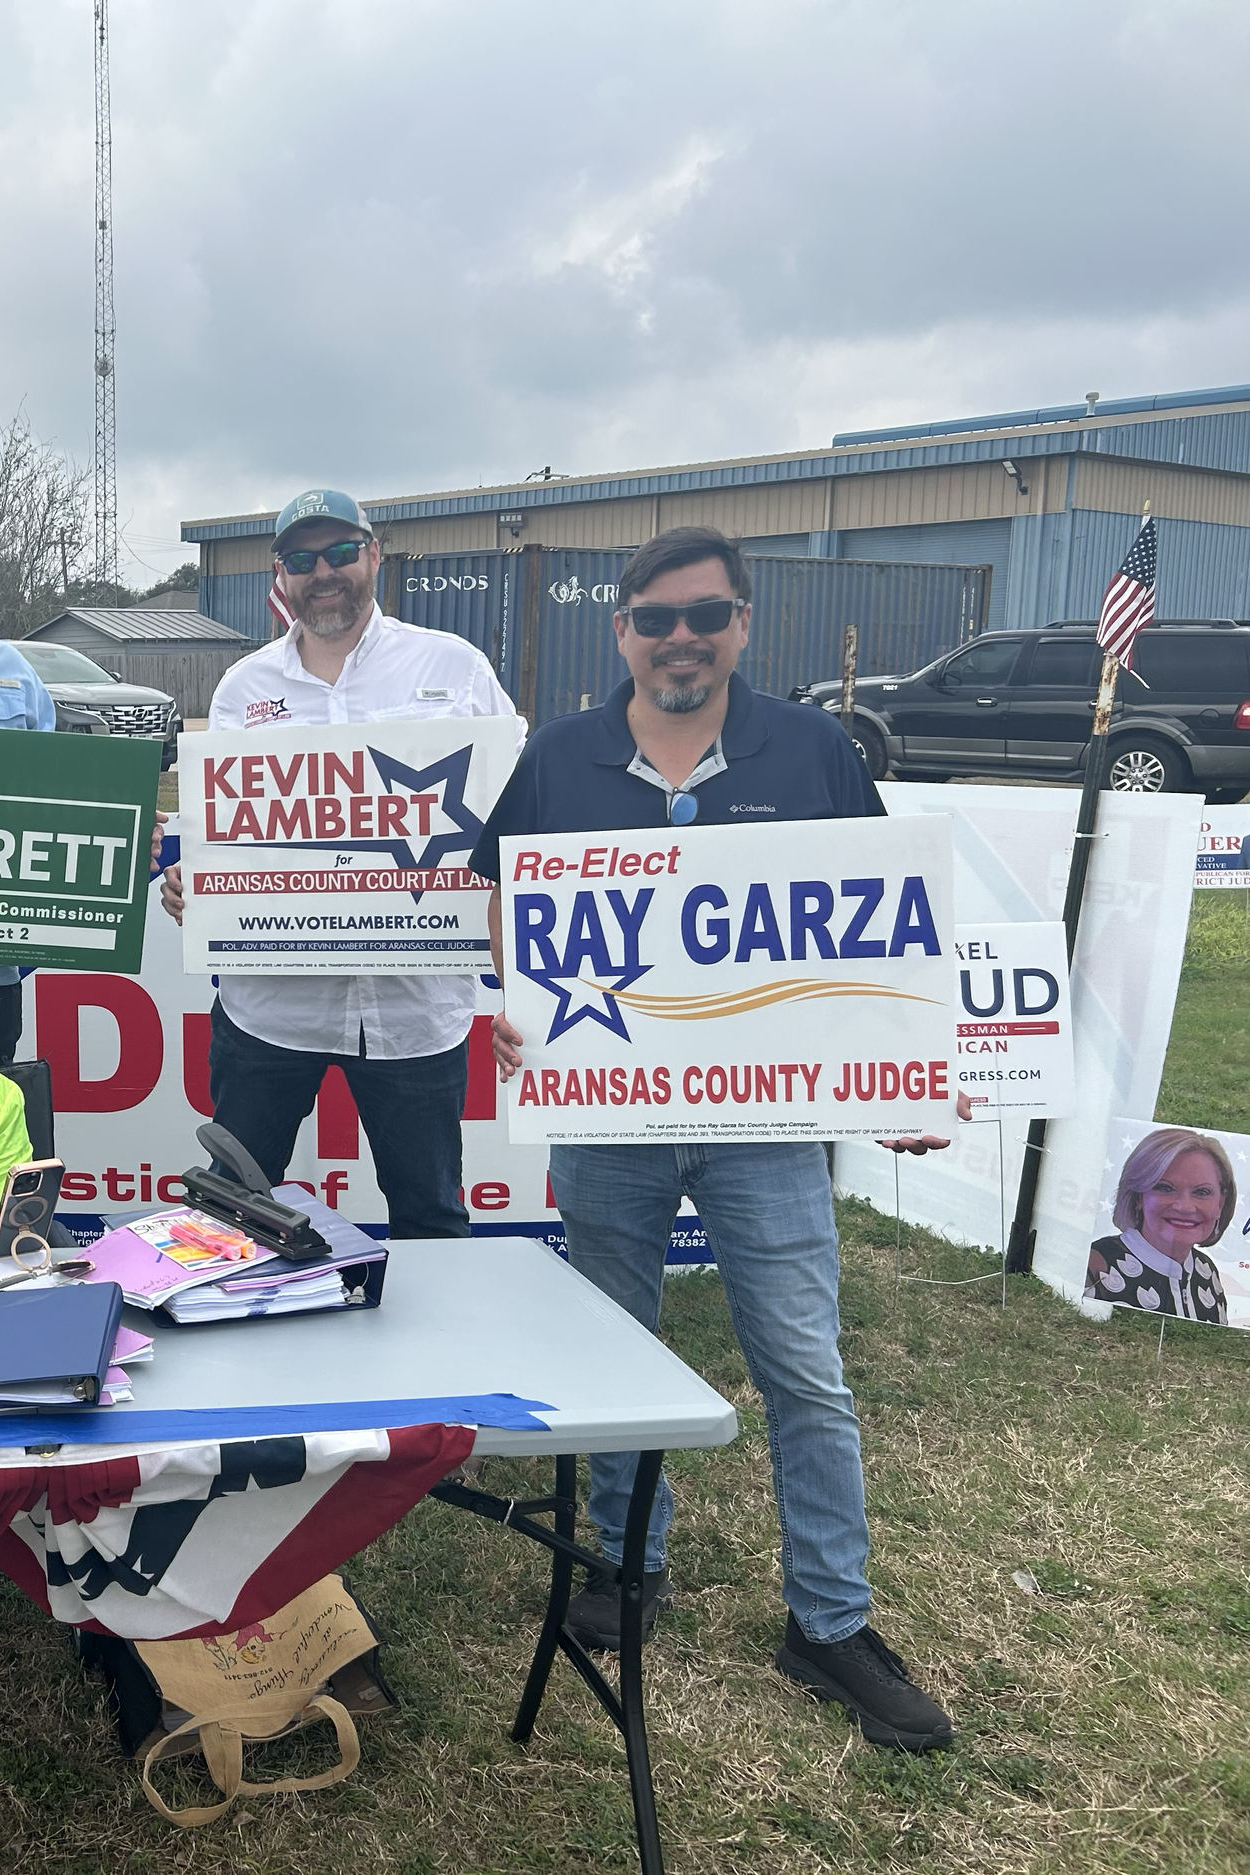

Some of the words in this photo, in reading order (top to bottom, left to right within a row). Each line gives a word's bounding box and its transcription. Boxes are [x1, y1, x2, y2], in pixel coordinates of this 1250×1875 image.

[292, 505, 330, 521] COSTA
[406, 575, 490, 592] CRONOS
[246, 700, 269, 712] KEVIN
[246, 704, 279, 719] LAMBERT
[203, 750, 366, 800] KEVIN
[739, 804, 776, 812] Columbia
[204, 793, 439, 842] LAMBERT
[334, 854, 354, 868] for
[512, 845, 682, 882] Re-Elect
[202, 872, 294, 892] ARANSAS
[296, 871, 364, 891] COUNTY
[365, 871, 430, 890] COURT
[432, 870, 456, 888] AT
[1196, 878, 1225, 886] RICT
[1228, 878, 1250, 886] JUD
[238, 914, 460, 931] WWW.VOTELAMBERT.COM
[513, 887, 656, 978] RAY
[681, 875, 942, 965] GARZA
[19, 928, 30, 940] 2
[333, 942, 368, 950] LAMBERT
[370, 942, 386, 950] FOR
[388, 942, 426, 950] ARANSAS
[427, 942, 444, 950] CCL
[447, 942, 475, 950] JUDGE
[960, 968, 1059, 1017] UD
[956, 1025, 1008, 1035] ESSMAN
[957, 1040, 1008, 1054] ICAN
[518, 1067, 671, 1106] ARANSAS
[682, 1063, 823, 1104] COUNTY
[832, 1060, 949, 1102] JUDGE
[959, 1070, 1041, 1081] GRESS.COM
[670, 1231, 689, 1239] ary
[672, 1239, 706, 1247] 78382
[293, 1603, 352, 1663] Wonderful
